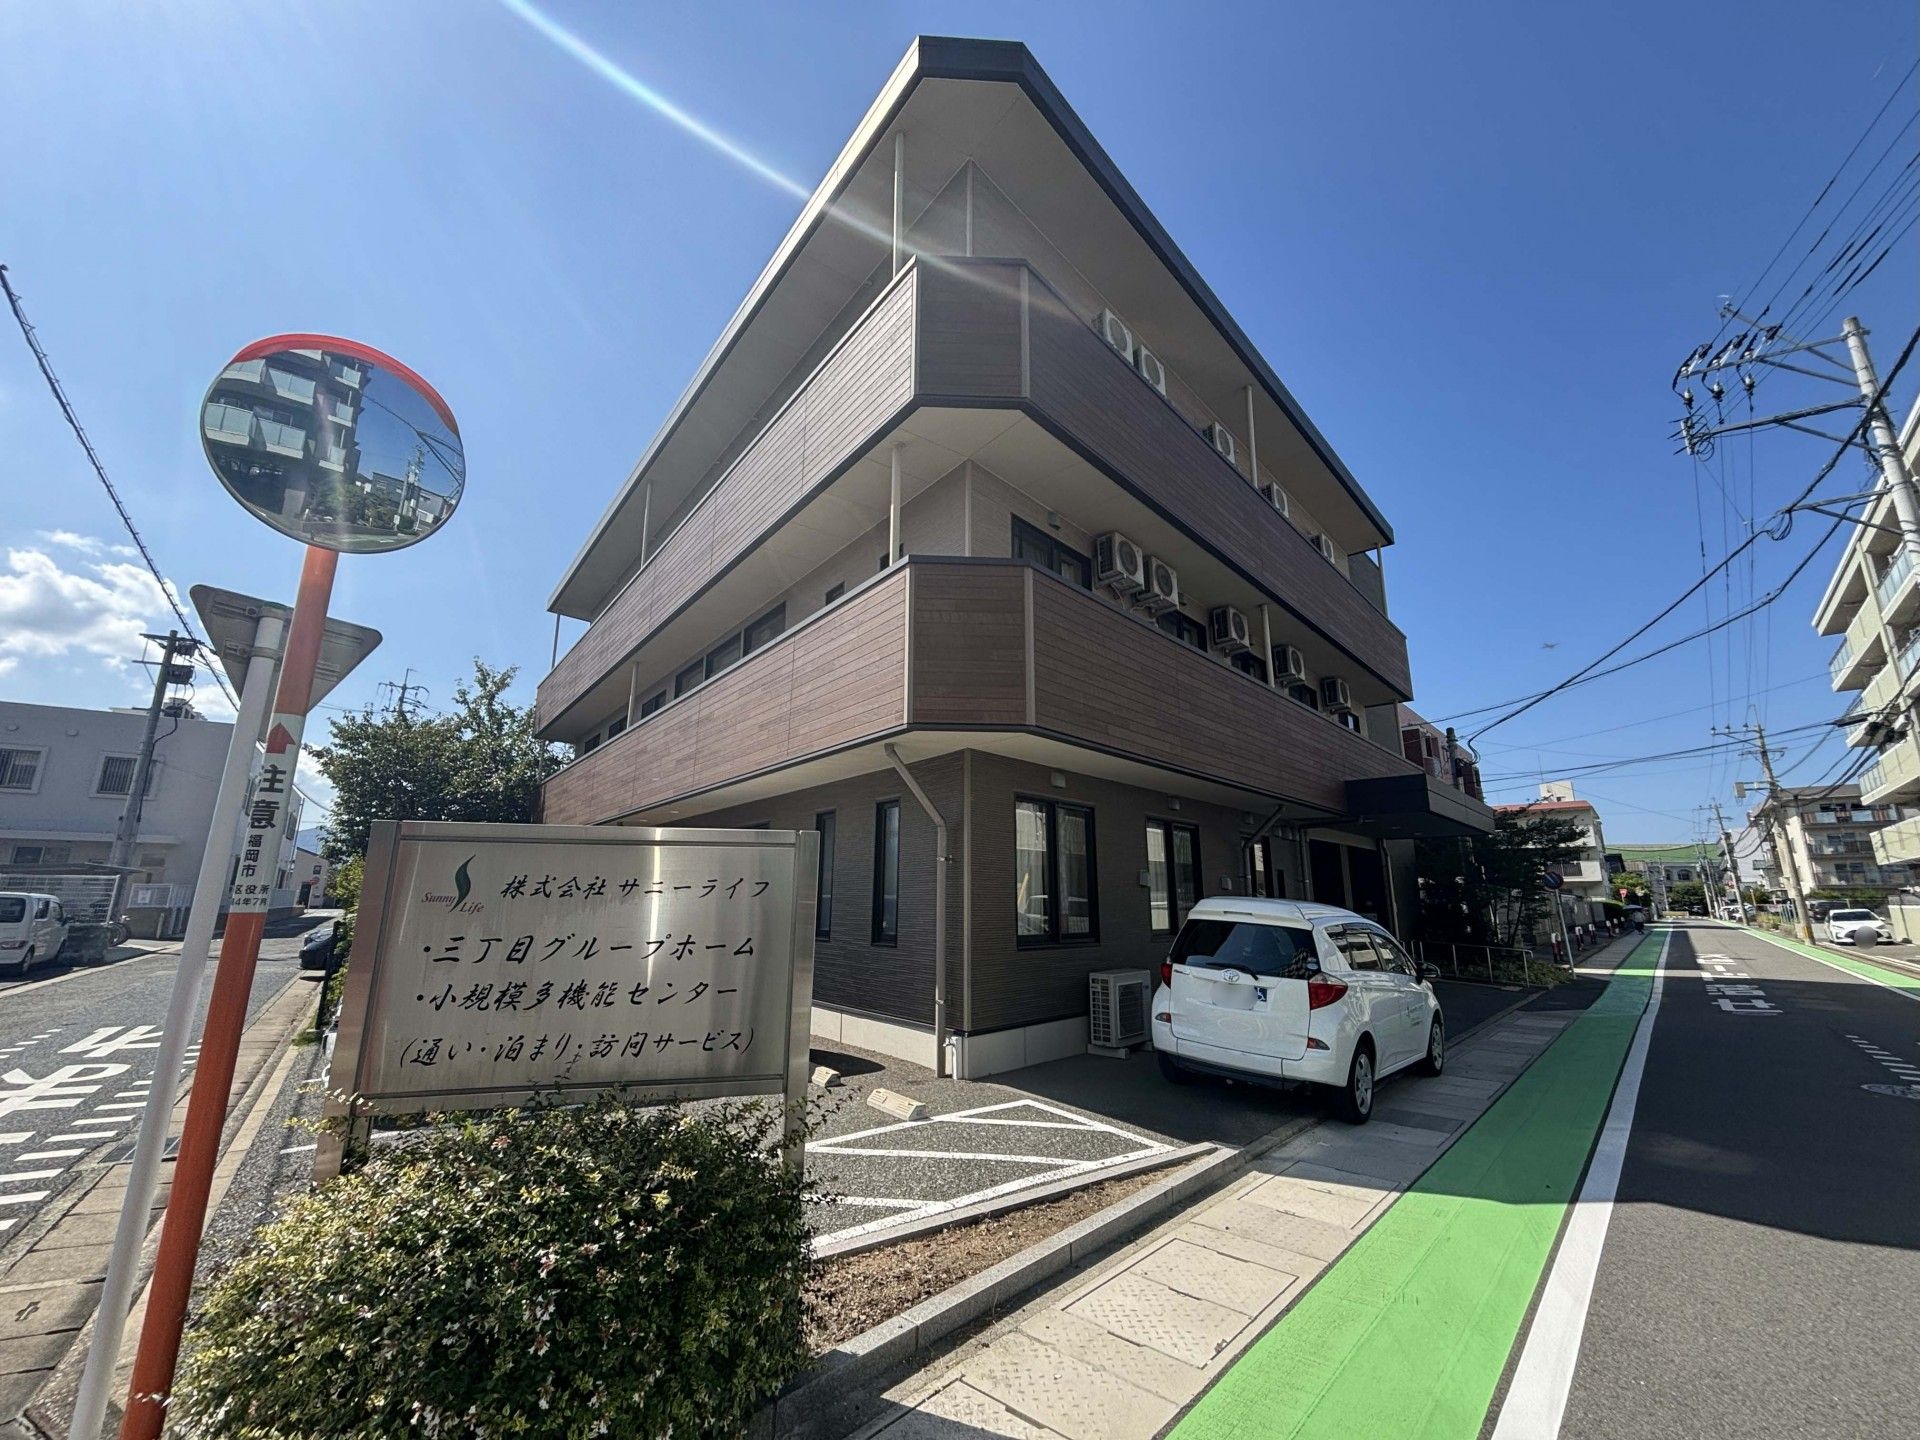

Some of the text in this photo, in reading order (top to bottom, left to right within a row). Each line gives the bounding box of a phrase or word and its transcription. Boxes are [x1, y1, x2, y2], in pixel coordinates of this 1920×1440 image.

[241, 834, 263, 878] 福岡市
[500, 874, 770, 901] 株式会社 サニーライフ
[421, 891, 485, 915] Sunny Life
